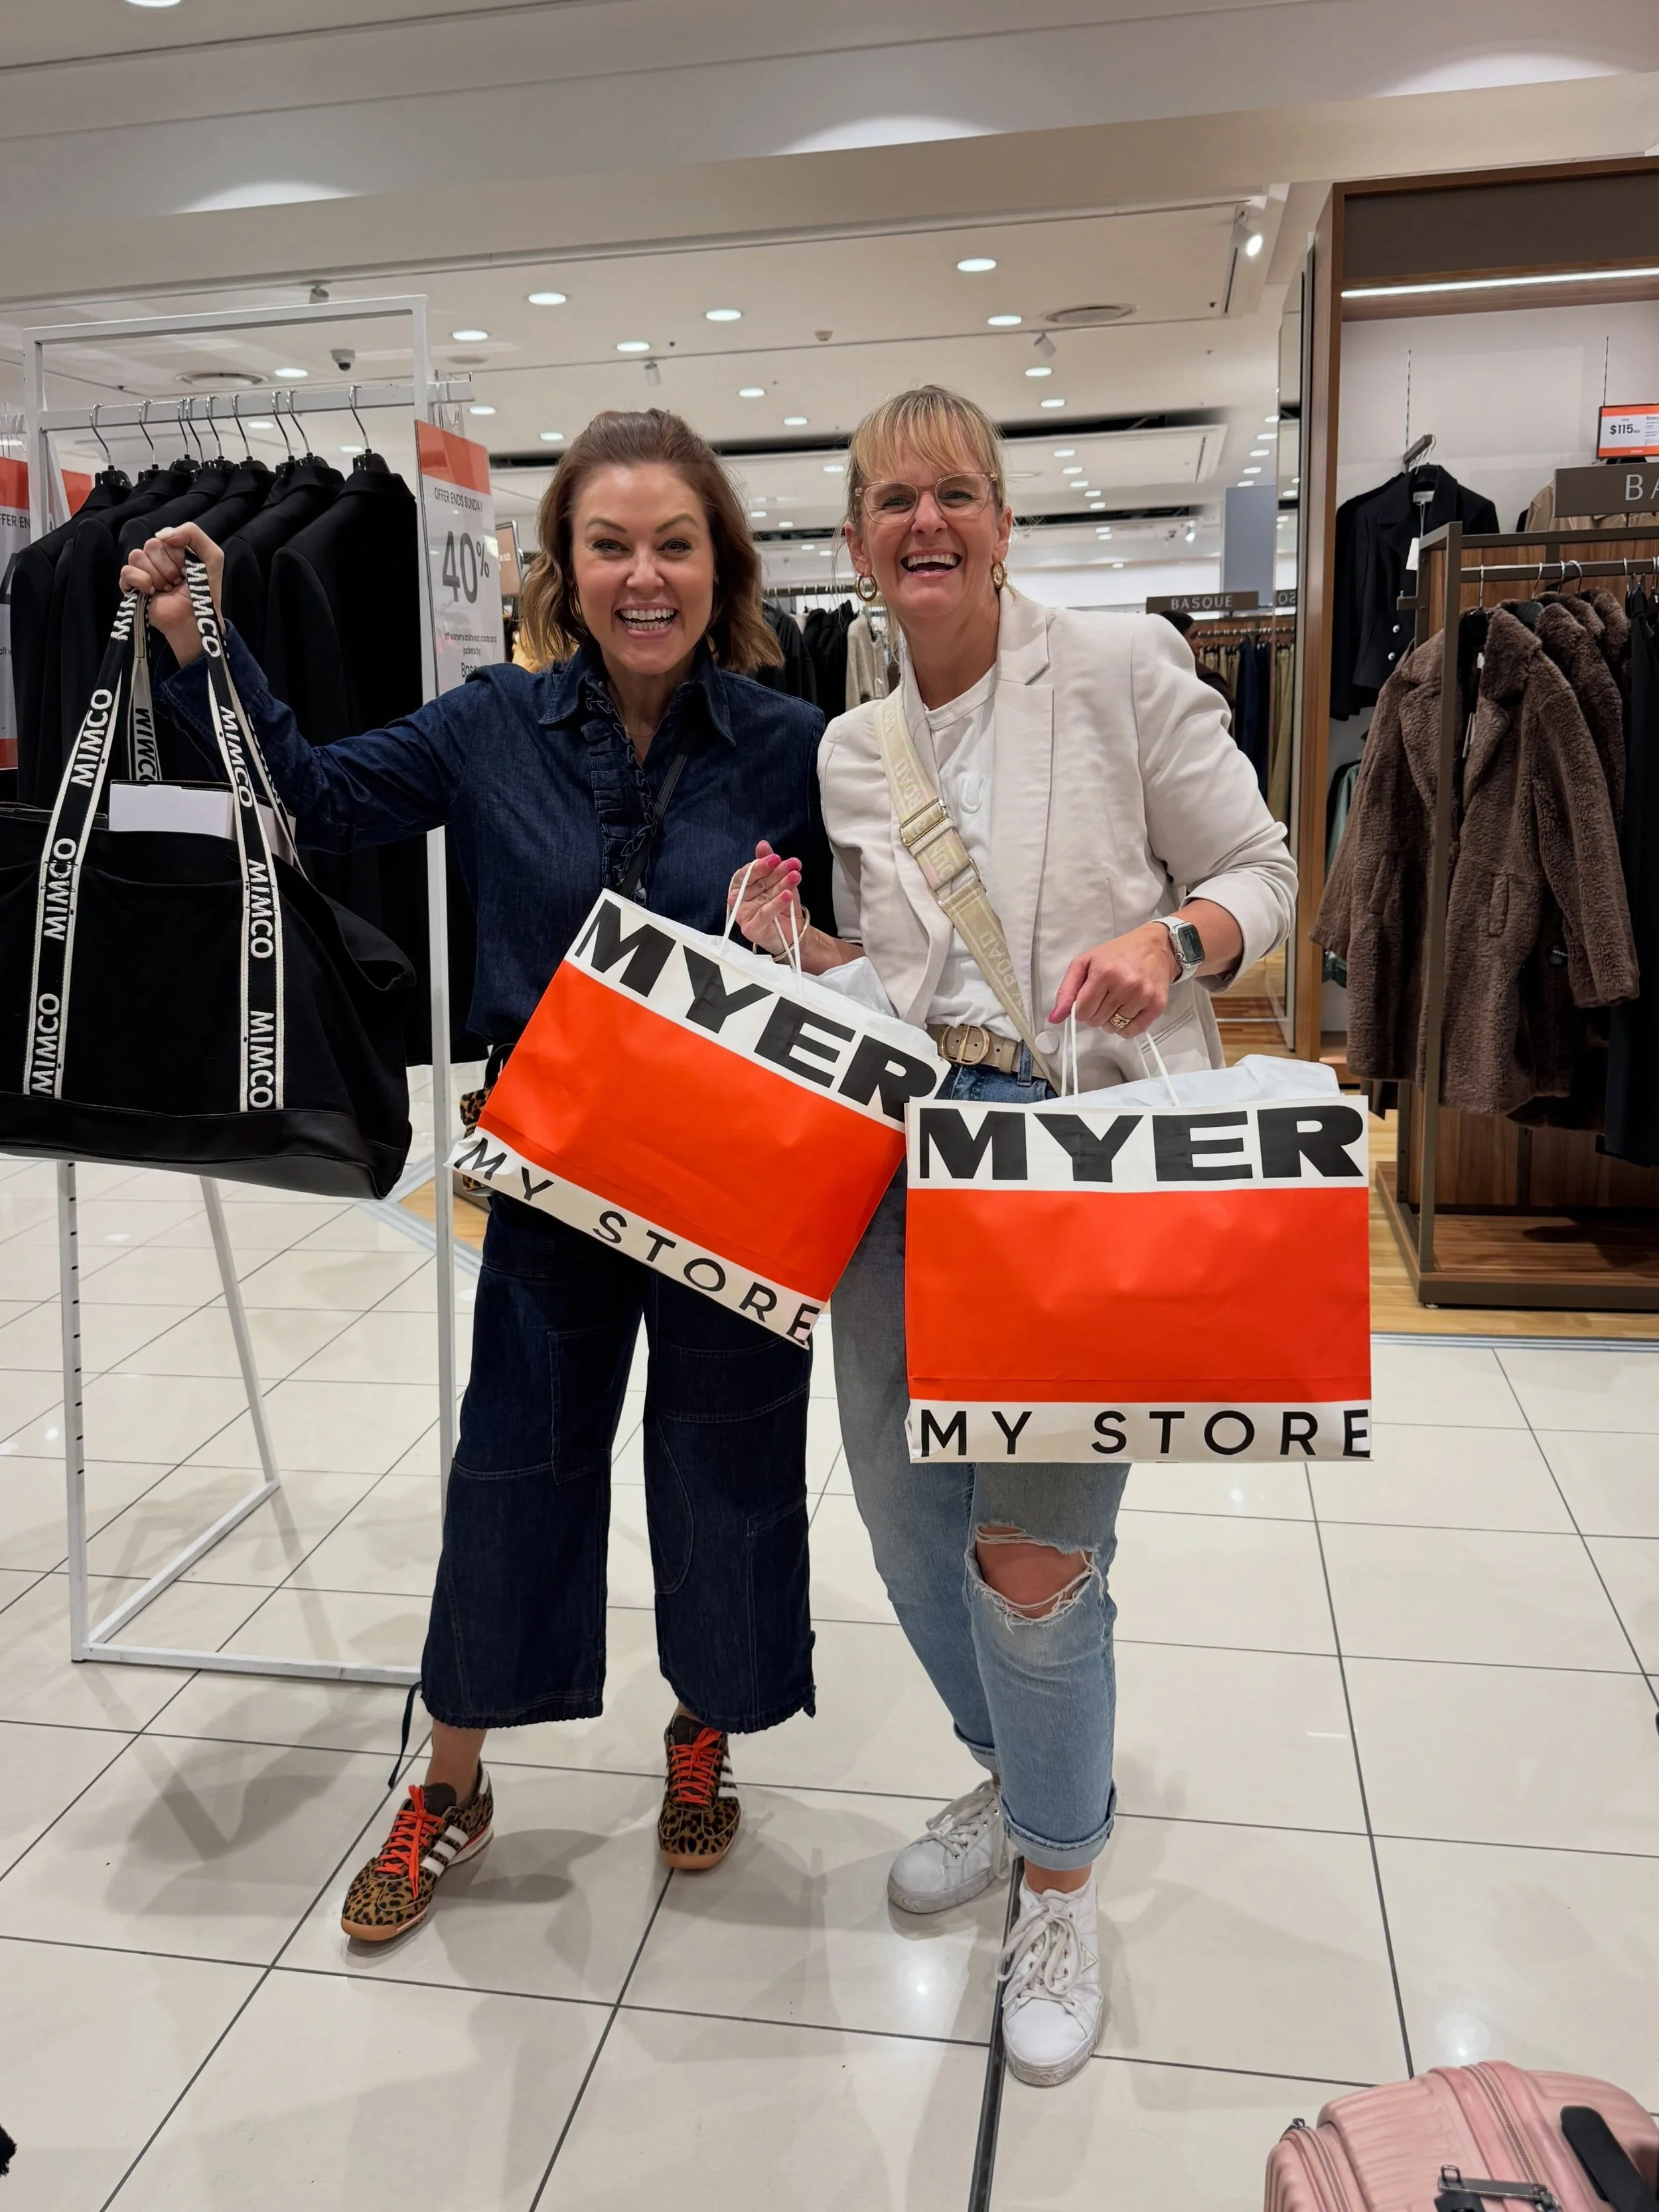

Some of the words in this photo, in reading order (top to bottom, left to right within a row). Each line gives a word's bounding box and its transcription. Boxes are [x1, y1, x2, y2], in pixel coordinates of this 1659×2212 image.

[435, 486, 450, 503] OFFER
[451, 492, 464, 508] ENDS
[465, 496, 483, 512] SUNDAY
[110, 589, 137, 640] MIM
[185, 558, 221, 658] MIMCO
[442, 530, 490, 603] 40%
[1171, 595, 1233, 611] BASQUE
[71, 688, 113, 788] MIMCO
[220, 705, 253, 808] MIMCO
[44, 838, 77, 940] MIMCO
[246, 859, 273, 958] MIMCO
[31, 993, 60, 1094] MIMCO
[250, 1010, 273, 1108] MIMCO
[575, 899, 937, 1123] MYER
[920, 1104, 1364, 1183] MYER
[453, 1137, 554, 1201] MY
[592, 1210, 820, 1345] STORE
[921, 1408, 1033, 1457] MY
[1091, 1408, 1370, 1458] STORE
